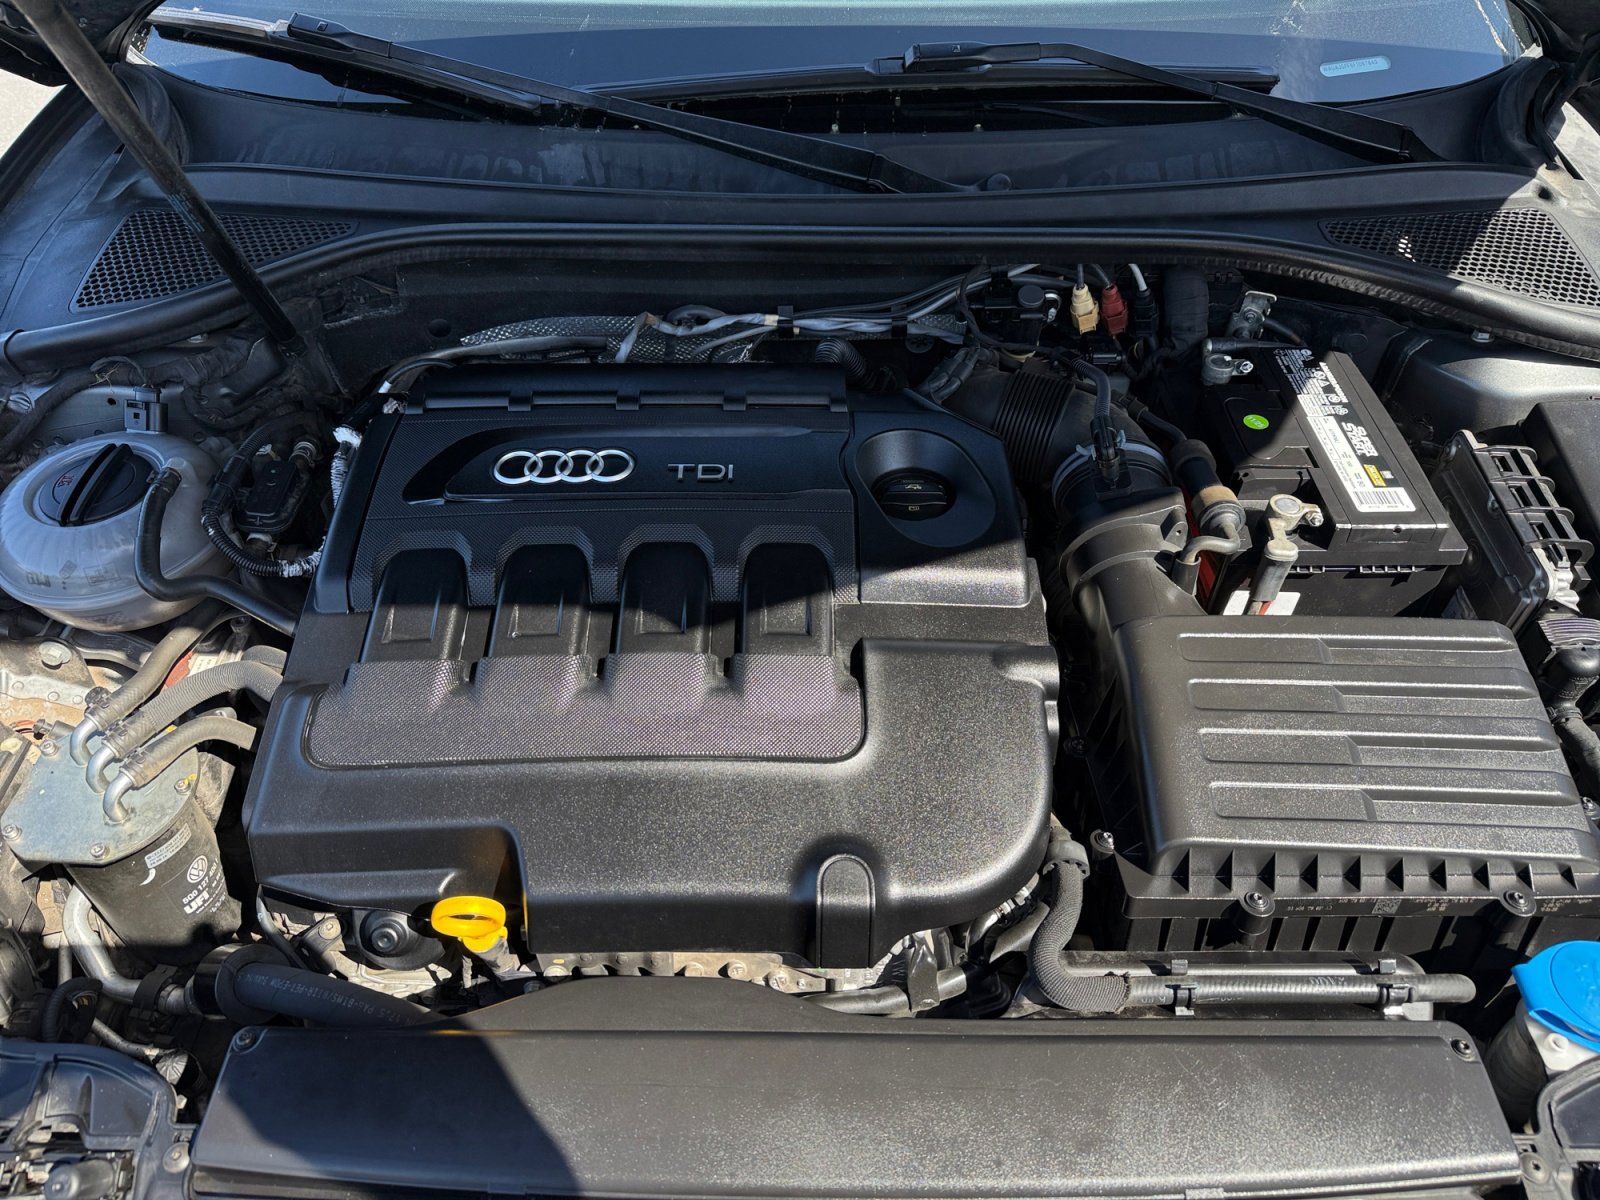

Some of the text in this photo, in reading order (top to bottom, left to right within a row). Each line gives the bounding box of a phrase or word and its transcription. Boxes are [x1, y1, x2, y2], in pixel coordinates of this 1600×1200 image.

[1341, 422, 1365, 456] START
[1354, 425, 1379, 457] SUPER
[667, 463, 734, 480] TDI
[198, 876, 209, 891] 127
[183, 888, 209, 914] UFI
